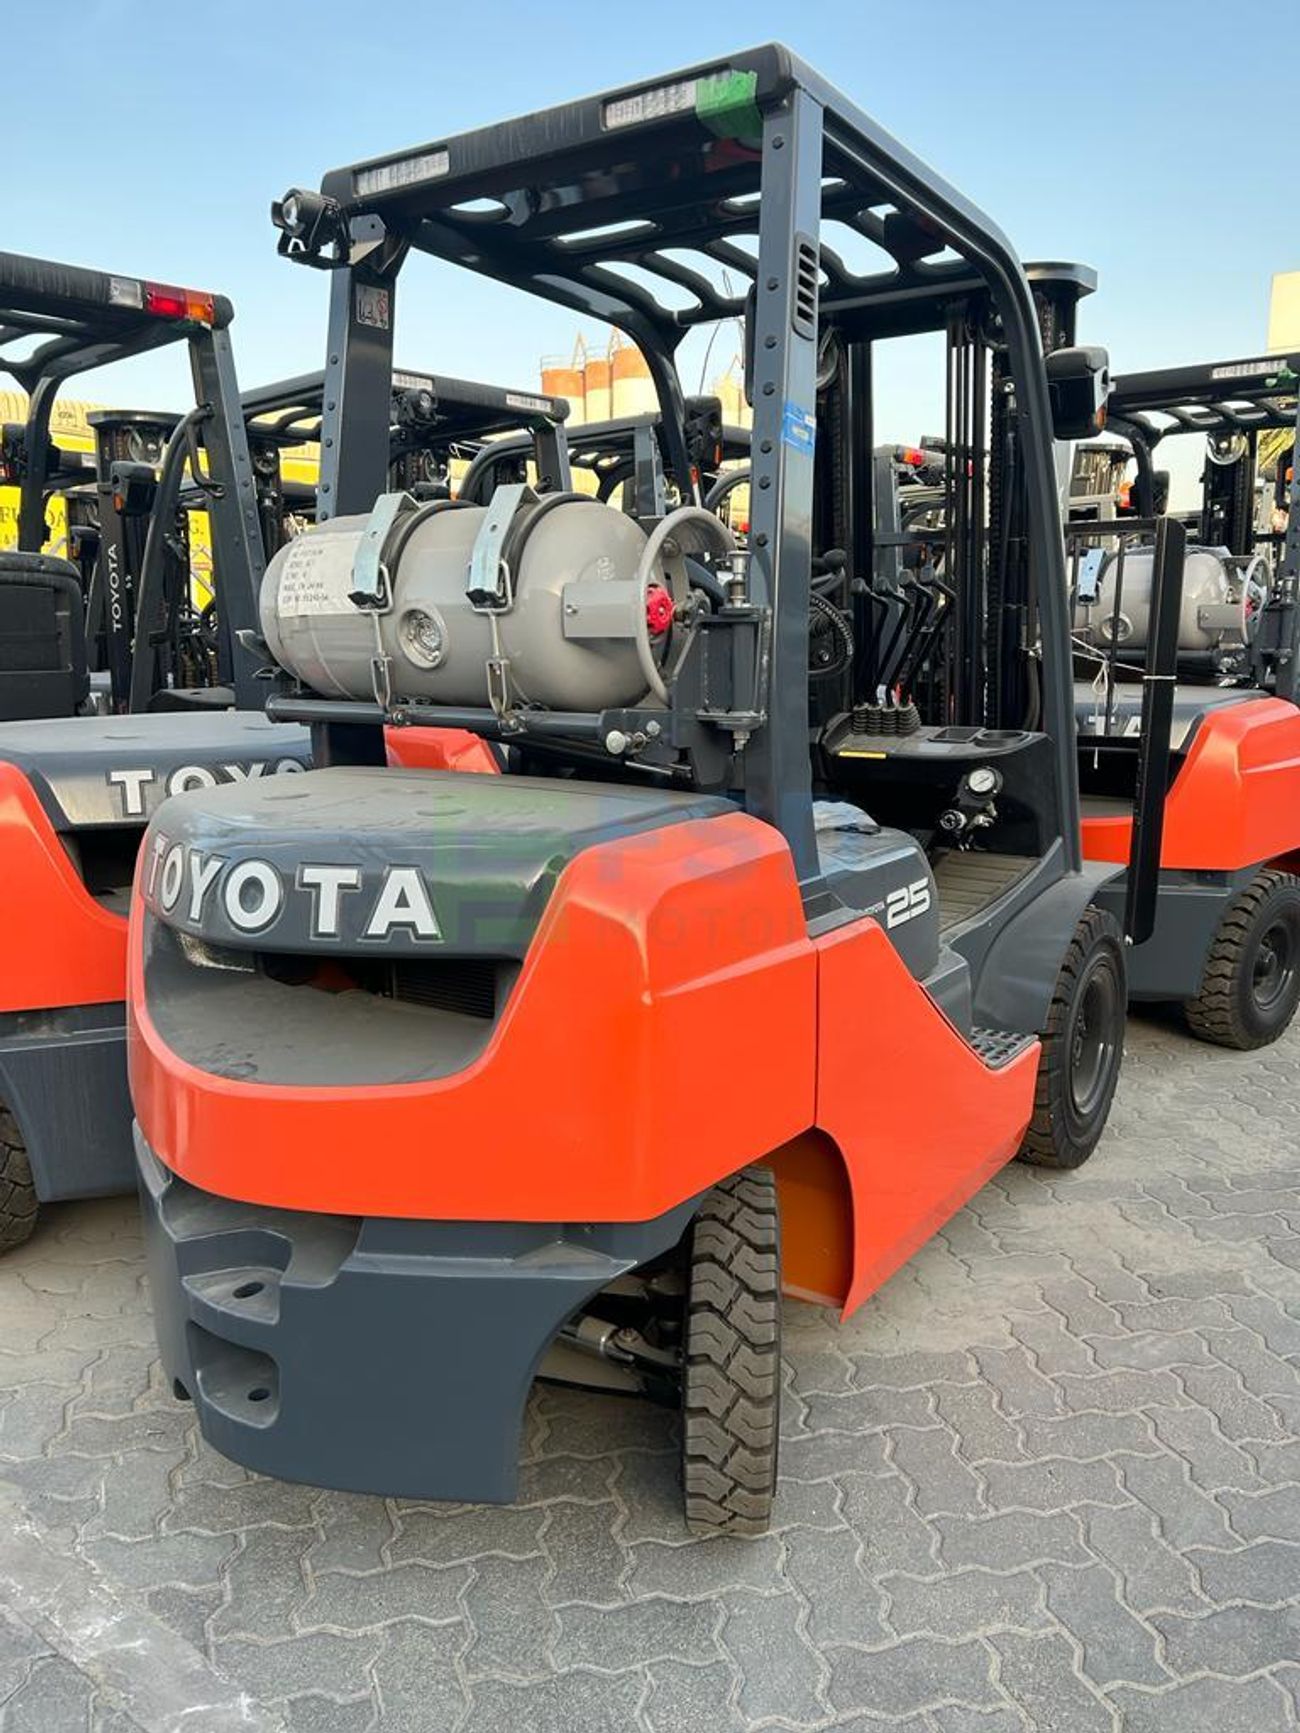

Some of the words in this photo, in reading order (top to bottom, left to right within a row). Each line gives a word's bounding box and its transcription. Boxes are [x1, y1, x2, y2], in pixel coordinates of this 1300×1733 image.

[108, 544, 122, 632] TOYOTA
[148, 834, 442, 940] TOYOTA
[886, 877, 930, 929] 25
